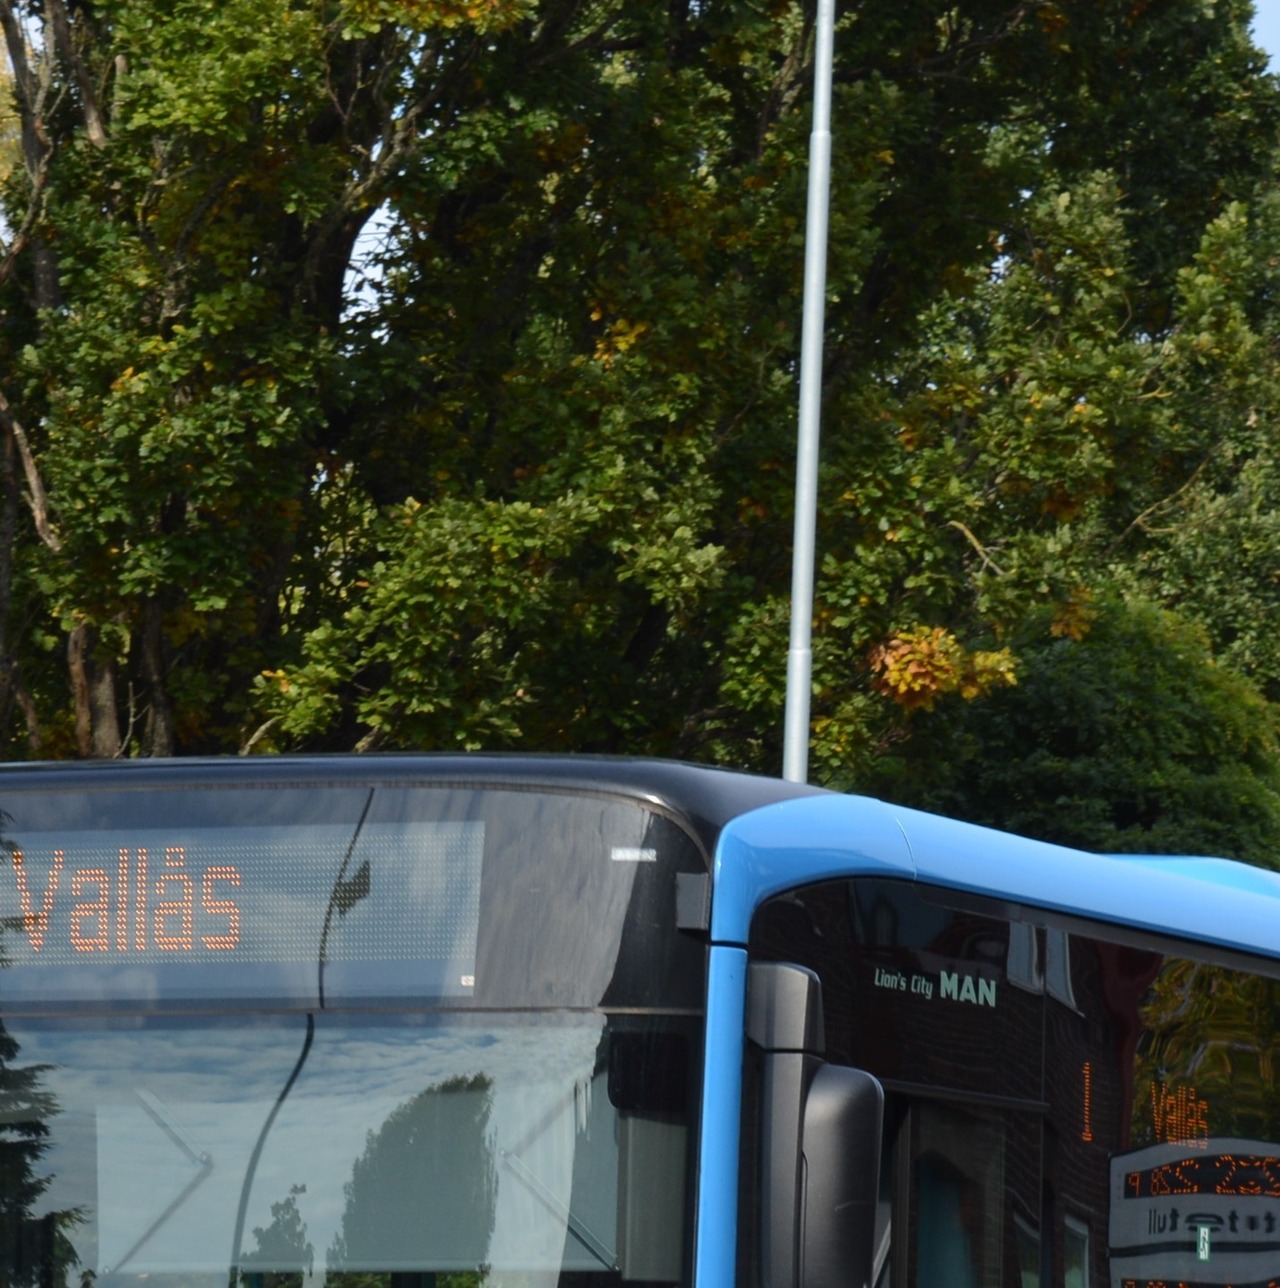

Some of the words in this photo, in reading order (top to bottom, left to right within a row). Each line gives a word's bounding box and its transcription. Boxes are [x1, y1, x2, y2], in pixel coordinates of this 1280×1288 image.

[12, 847, 241, 952] Vallås
[874, 968, 906, 991] Lion's
[911, 975, 933, 999] City
[940, 970, 996, 1008] MAN
[1151, 1081, 1208, 1149] Vallås
